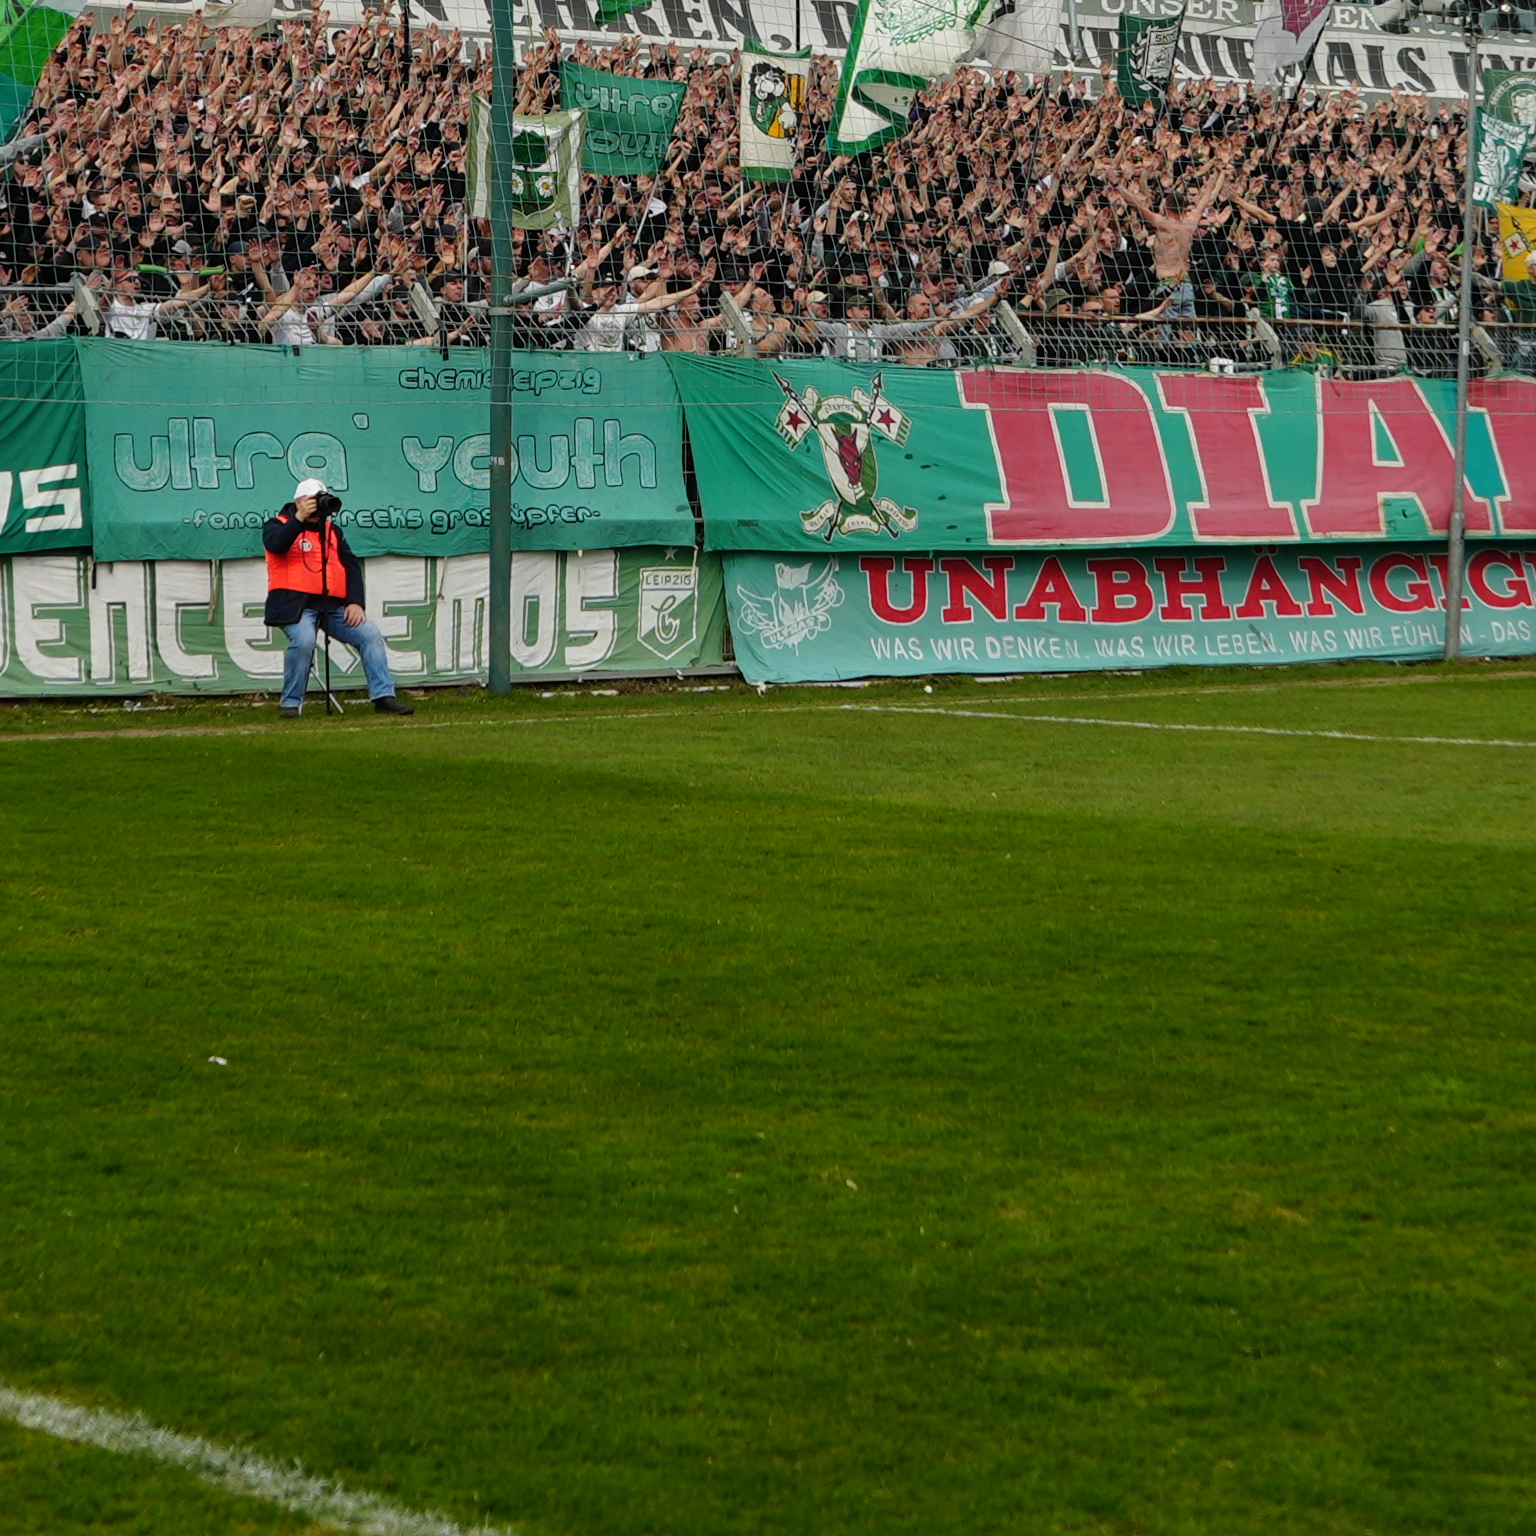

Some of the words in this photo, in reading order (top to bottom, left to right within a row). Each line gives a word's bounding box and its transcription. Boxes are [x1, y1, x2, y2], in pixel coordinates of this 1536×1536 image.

[645, 574, 692, 586] LEIPZIG
[870, 637, 924, 661] WAS
[930, 637, 979, 661] WIR
[1094, 635, 1146, 658] WAS
[1152, 633, 1195, 657] WIR
[1289, 629, 1338, 653] WAS
[1344, 626, 1385, 651] WIR
[1391, 619, 1473, 648] FÜHLN
[1491, 620, 1532, 643] DAS
